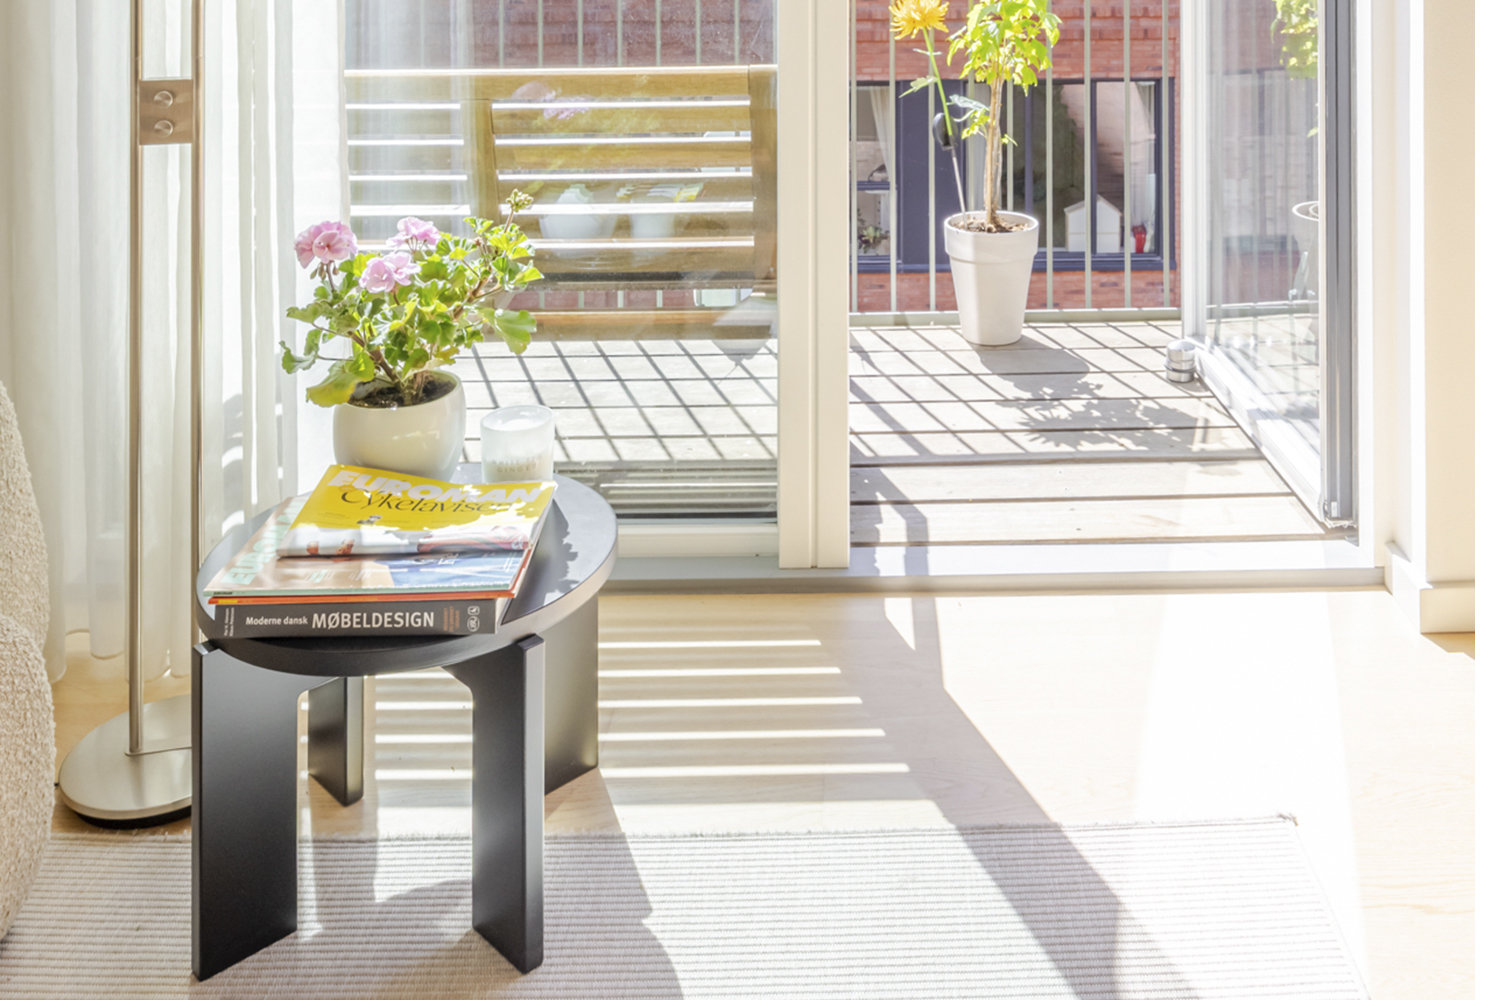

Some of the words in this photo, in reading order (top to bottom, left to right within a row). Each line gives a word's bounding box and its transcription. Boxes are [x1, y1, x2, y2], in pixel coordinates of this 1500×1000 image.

[327, 470, 542, 503] EUROMAN
[245, 616, 282, 626] Moderne
[282, 615, 308, 625] dansk
[311, 611, 435, 630] MØBELDESIGN
